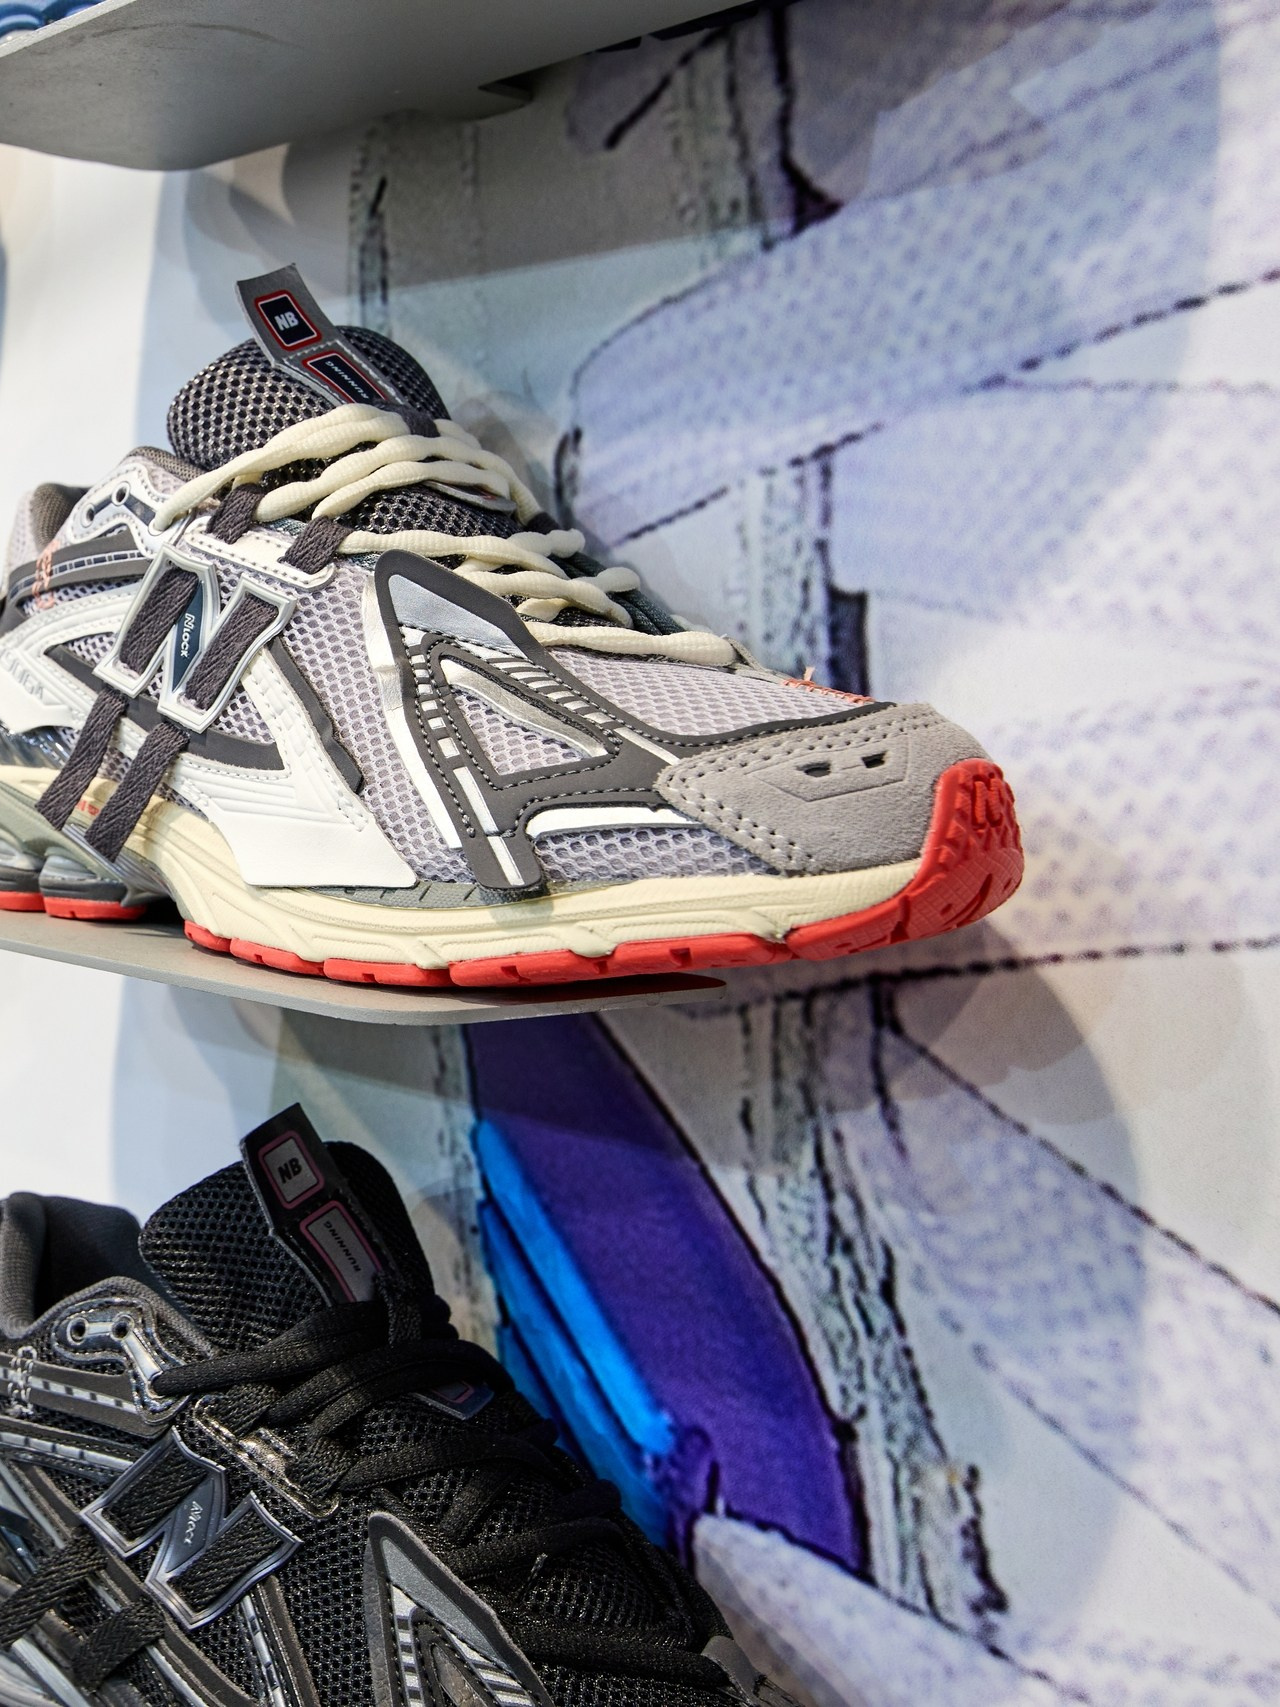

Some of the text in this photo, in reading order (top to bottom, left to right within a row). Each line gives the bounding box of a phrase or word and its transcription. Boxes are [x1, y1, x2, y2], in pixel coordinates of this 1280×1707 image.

[274, 311, 300, 331] NB
[324, 360, 370, 399] RUNNING
[278, 1157, 303, 1184] NB
[323, 1221, 361, 1272] RUNNING
